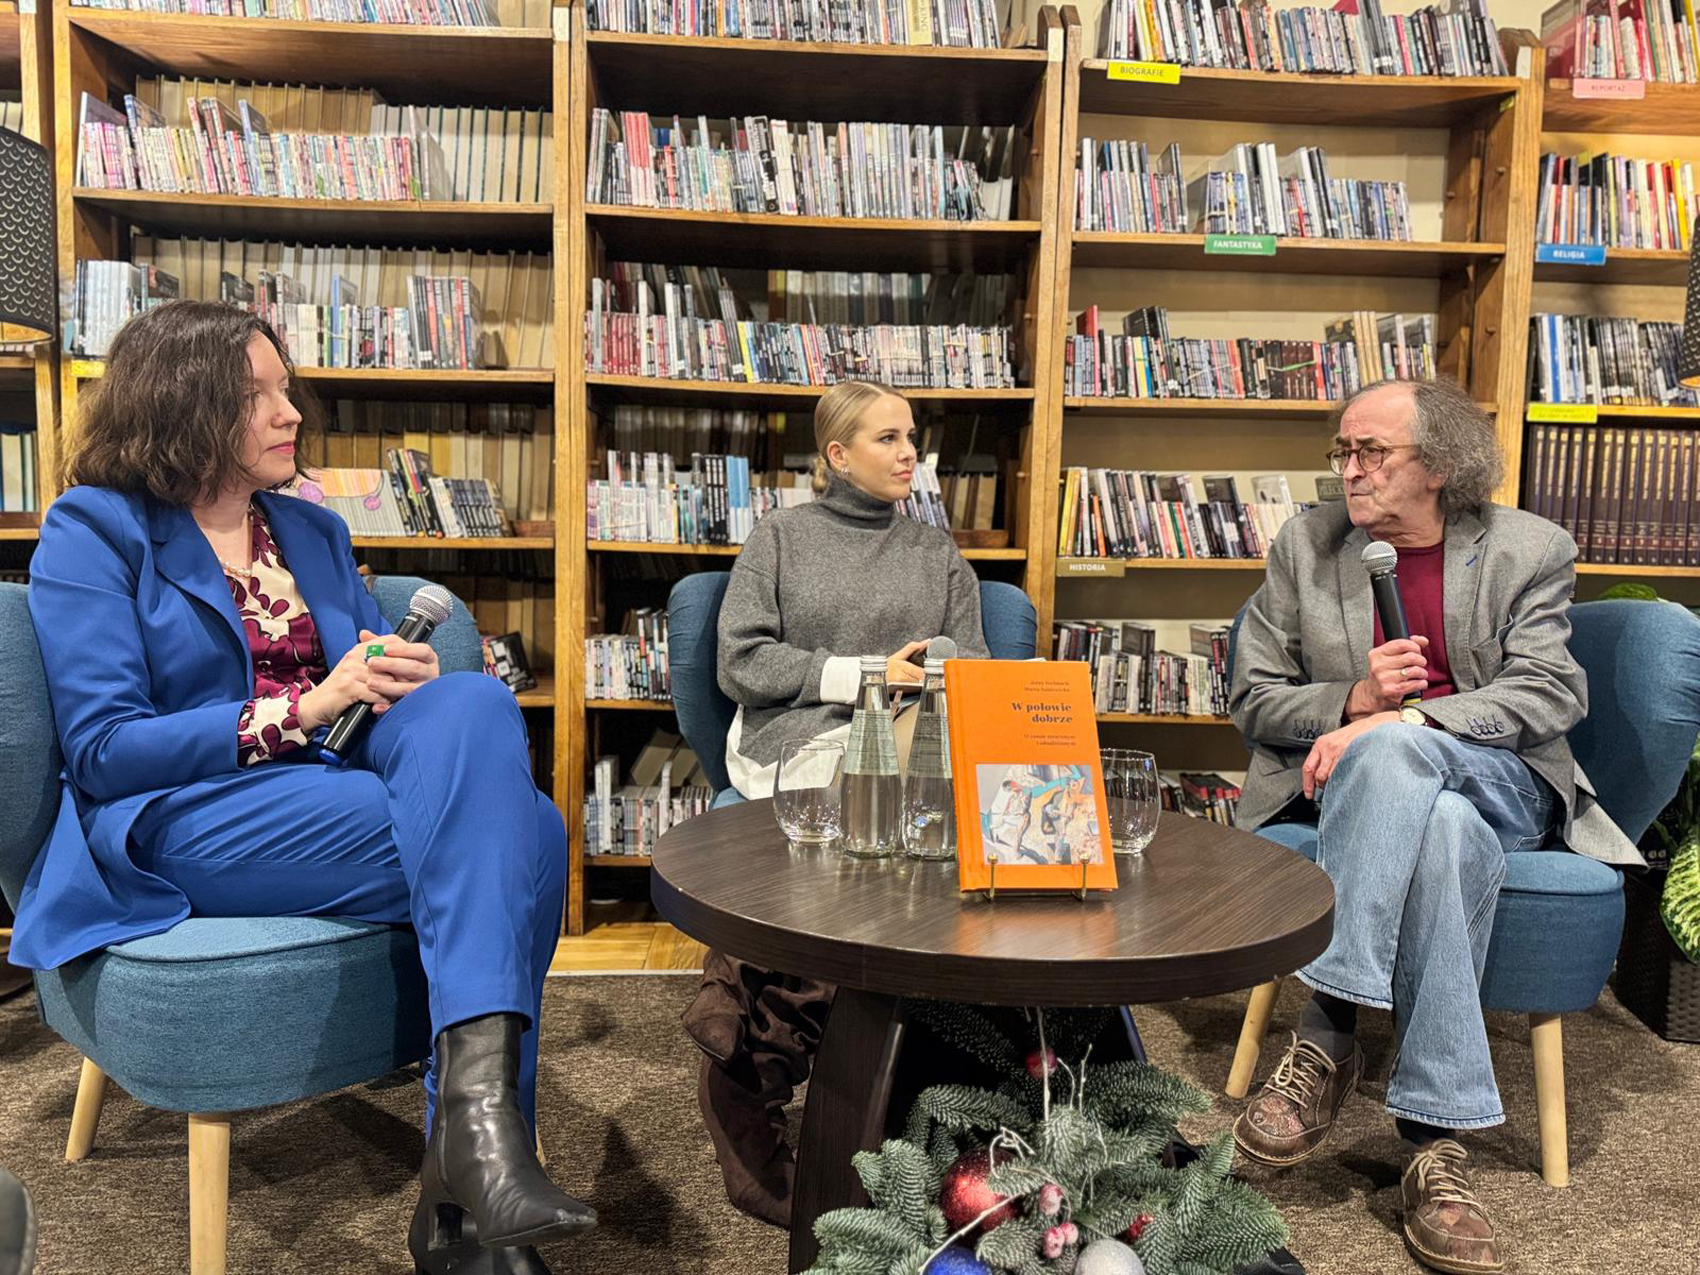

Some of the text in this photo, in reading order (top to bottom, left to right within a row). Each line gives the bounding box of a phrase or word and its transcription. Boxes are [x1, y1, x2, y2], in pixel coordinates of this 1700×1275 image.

[1120, 66, 1164, 77] BIOGRAFIE
[1213, 240, 1263, 249] FANTASTYKA
[1553, 250, 1586, 259] RELIGIA
[1069, 563, 1106, 571] HISTORIA
[1011, 702, 1023, 711] W
[1031, 713, 1073, 723] dobrze
